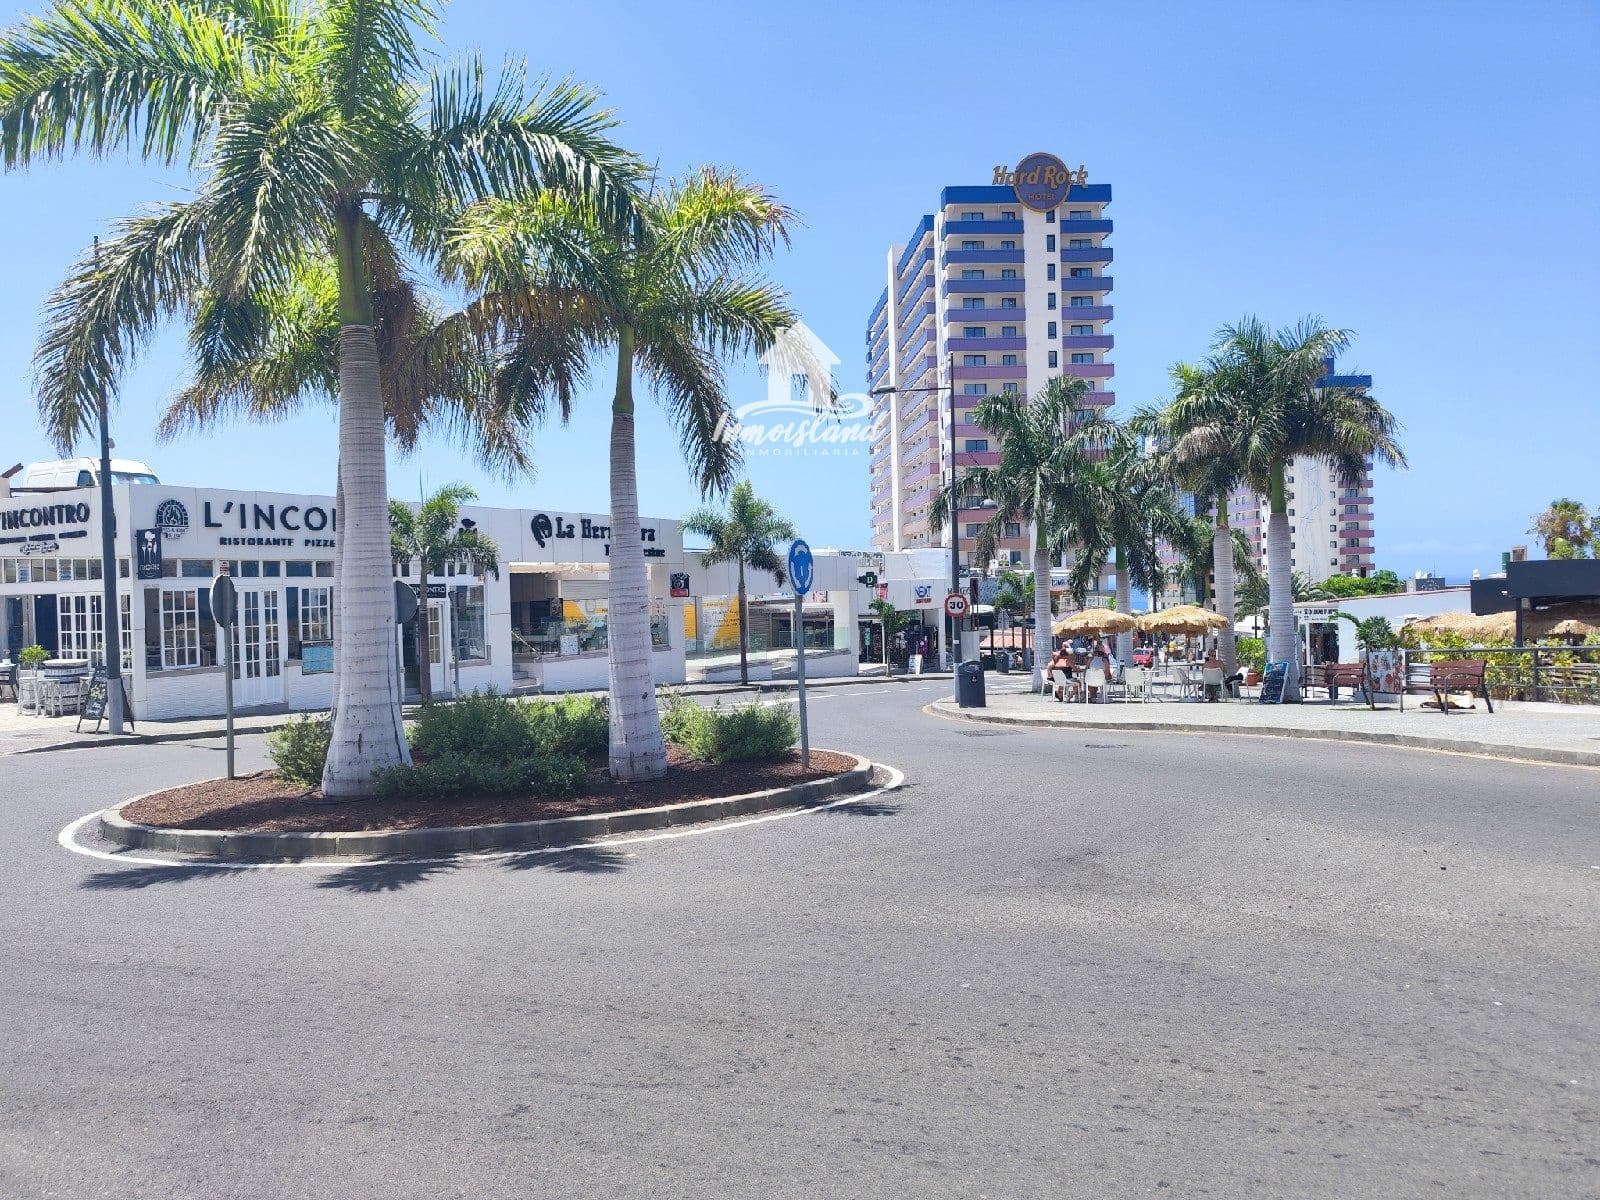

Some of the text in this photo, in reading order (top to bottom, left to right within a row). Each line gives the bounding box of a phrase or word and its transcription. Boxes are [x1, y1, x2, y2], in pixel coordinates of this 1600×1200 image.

[992, 165, 1088, 189] Hard Rock
[0, 502, 90, 530] INCONTRO
[555, 516, 575, 538] La
[219, 537, 336, 548] RISTORANTE PIZZE
[949, 601, 964, 609] 30
